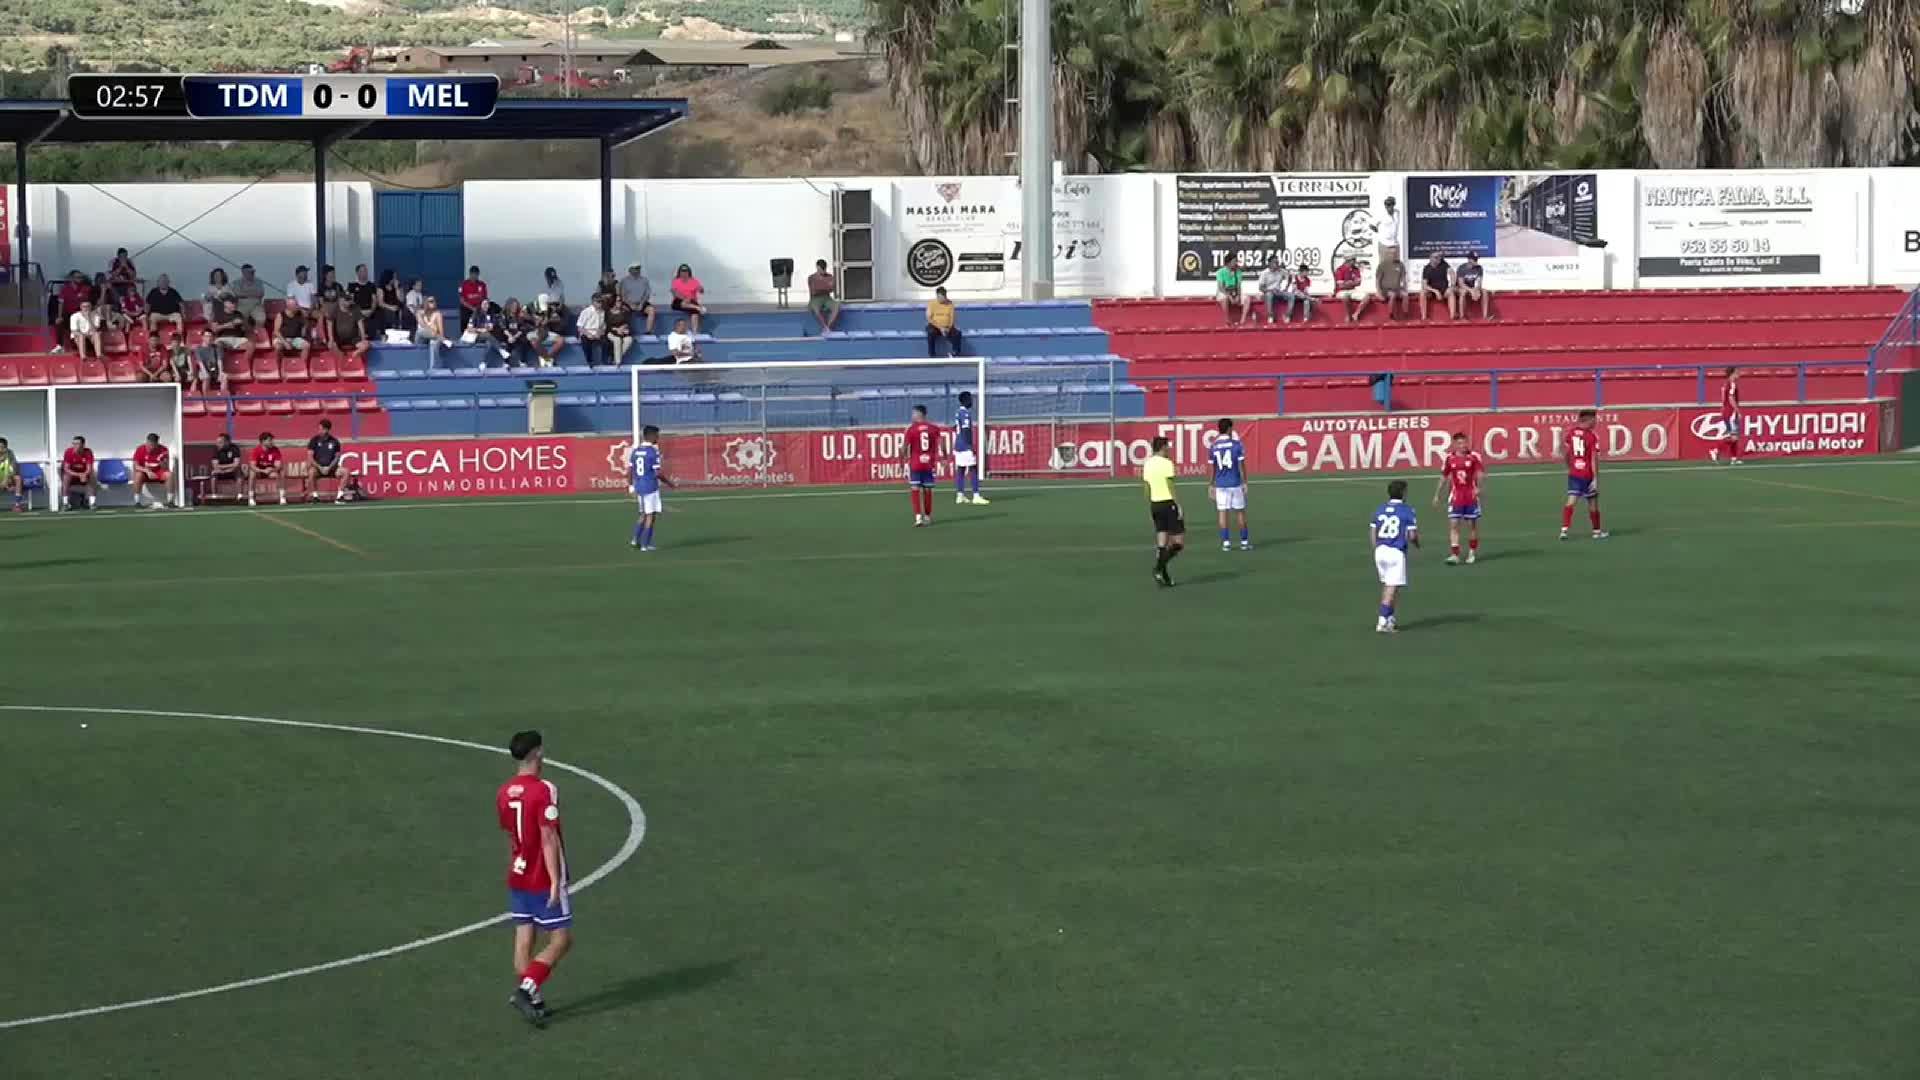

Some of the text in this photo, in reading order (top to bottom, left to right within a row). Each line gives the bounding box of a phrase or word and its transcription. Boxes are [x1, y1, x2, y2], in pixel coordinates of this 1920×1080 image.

[906, 205, 996, 216] MASSAI MARA
[1236, 249, 1263, 267] 952
[1295, 248, 1321, 267] 939
[1680, 240, 1706, 254] 952
[1302, 416, 1430, 433] AUTOTALLERES
[1744, 411, 1867, 436] HYUNDAI
[822, 434, 862, 461] U.D.
[920, 431, 929, 451] 6
[1276, 430, 1451, 472] GAMAR
[1483, 423, 1668, 460] CRIDO
[1818, 437, 1865, 449] Motor
[338, 450, 450, 475] CHECA
[459, 445, 567, 472] HOMES
[636, 457, 644, 476] 8
[1213, 449, 1233, 471] 14
[418, 475, 567, 492] INMOBILIARIO
[1378, 514, 1400, 539] 28
[508, 801, 522, 843] 7
